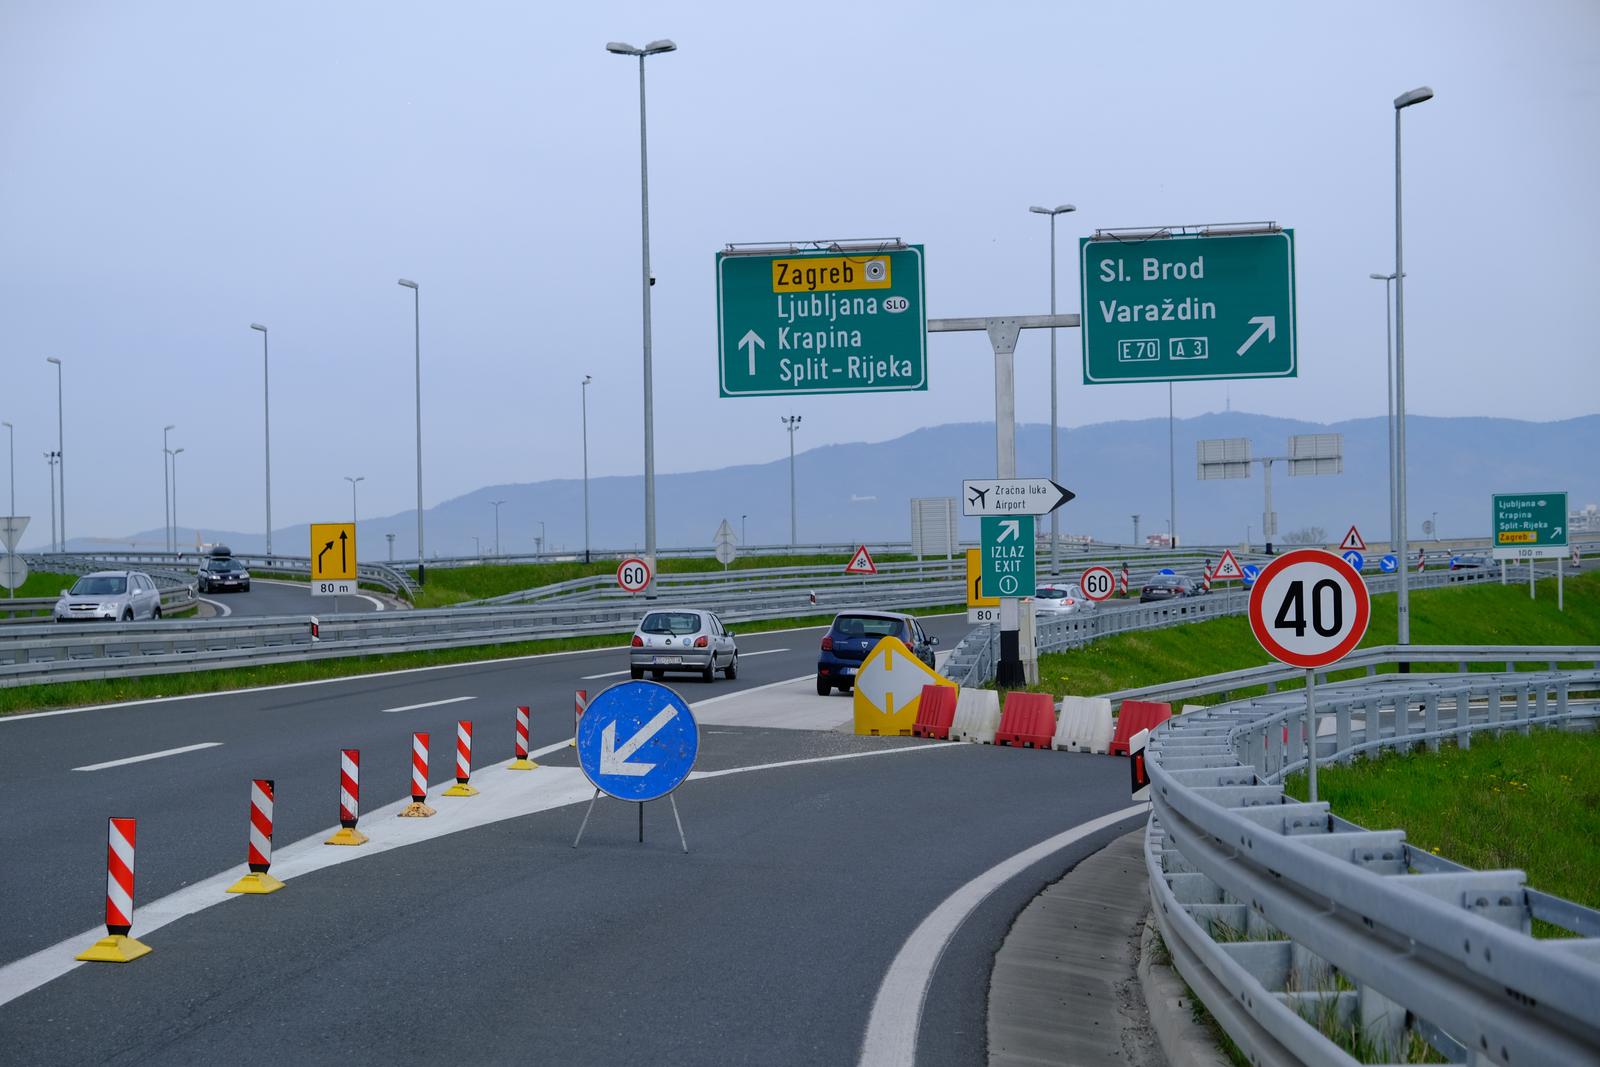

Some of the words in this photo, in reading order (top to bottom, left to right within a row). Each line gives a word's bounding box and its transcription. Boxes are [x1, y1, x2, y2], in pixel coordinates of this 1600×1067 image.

[777, 260, 854, 290] Zagreb
[1099, 258, 1131, 282] Sl.
[1142, 255, 1204, 281] Brod
[777, 292, 878, 324] Ljubljana
[885, 299, 907, 310] SLO
[1099, 297, 1216, 323] Varaždin
[778, 325, 862, 354] Krapina
[1123, 343, 1131, 358] E
[1136, 342, 1156, 358] 70
[1176, 342, 1185, 356] A
[1194, 341, 1202, 356] 3
[1028, 485, 1047, 494] luka
[995, 500, 1026, 511] Airport
[1498, 500, 1536, 509] Ljubljana
[1499, 512, 1532, 520] Krapina
[1500, 533, 1528, 542] Zagreb
[991, 546, 1025, 558] IZLAZ
[995, 560, 1022, 573] EXIT
[624, 567, 644, 584] 60
[320, 583, 335, 593] 80
[1088, 575, 1108, 593] 60
[977, 610, 992, 620] 80
[1274, 578, 1343, 638] 40
